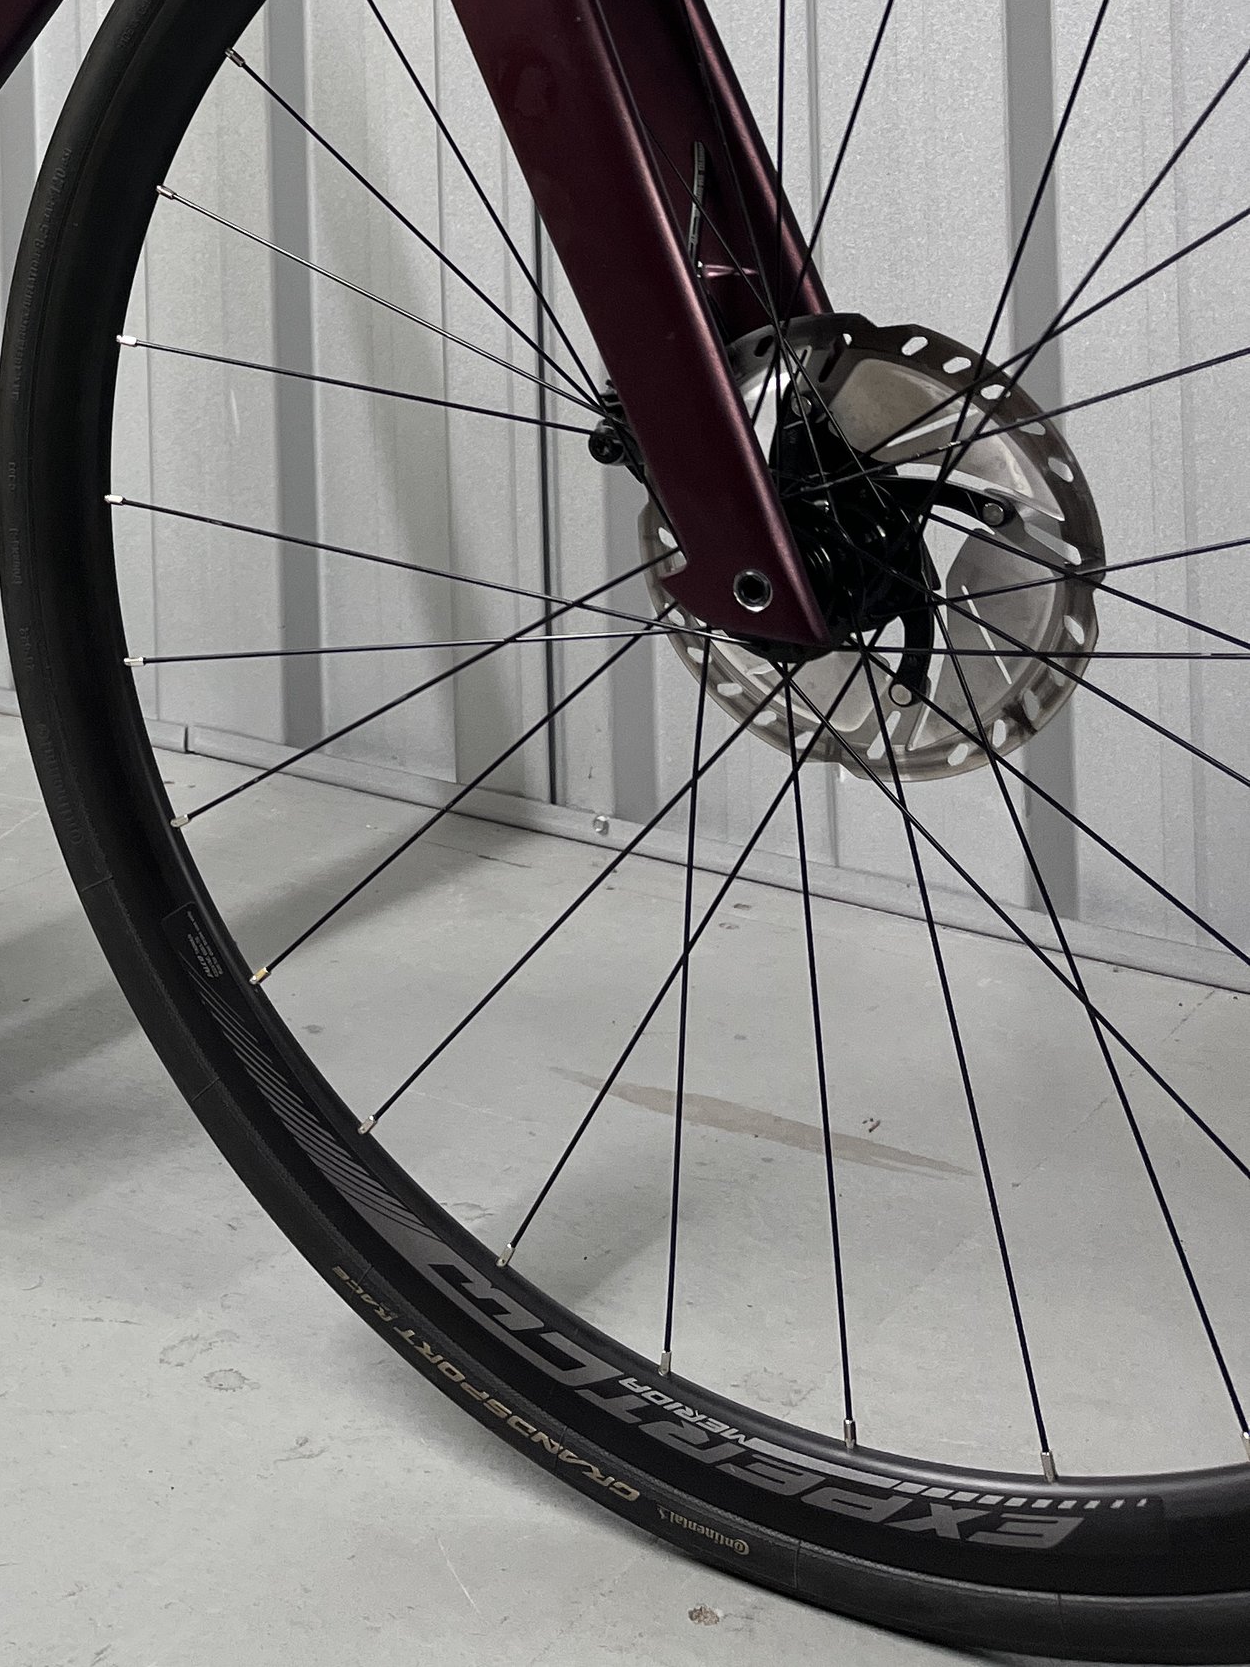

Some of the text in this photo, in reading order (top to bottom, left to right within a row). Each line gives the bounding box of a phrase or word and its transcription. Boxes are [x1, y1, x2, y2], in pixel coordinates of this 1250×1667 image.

[332, 1265, 641, 1502] GRANDSPORT RACE
[618, 1376, 751, 1443] MERIDA
[576, 1386, 1084, 1549] EXPERT
[668, 1512, 751, 1557] Continental
